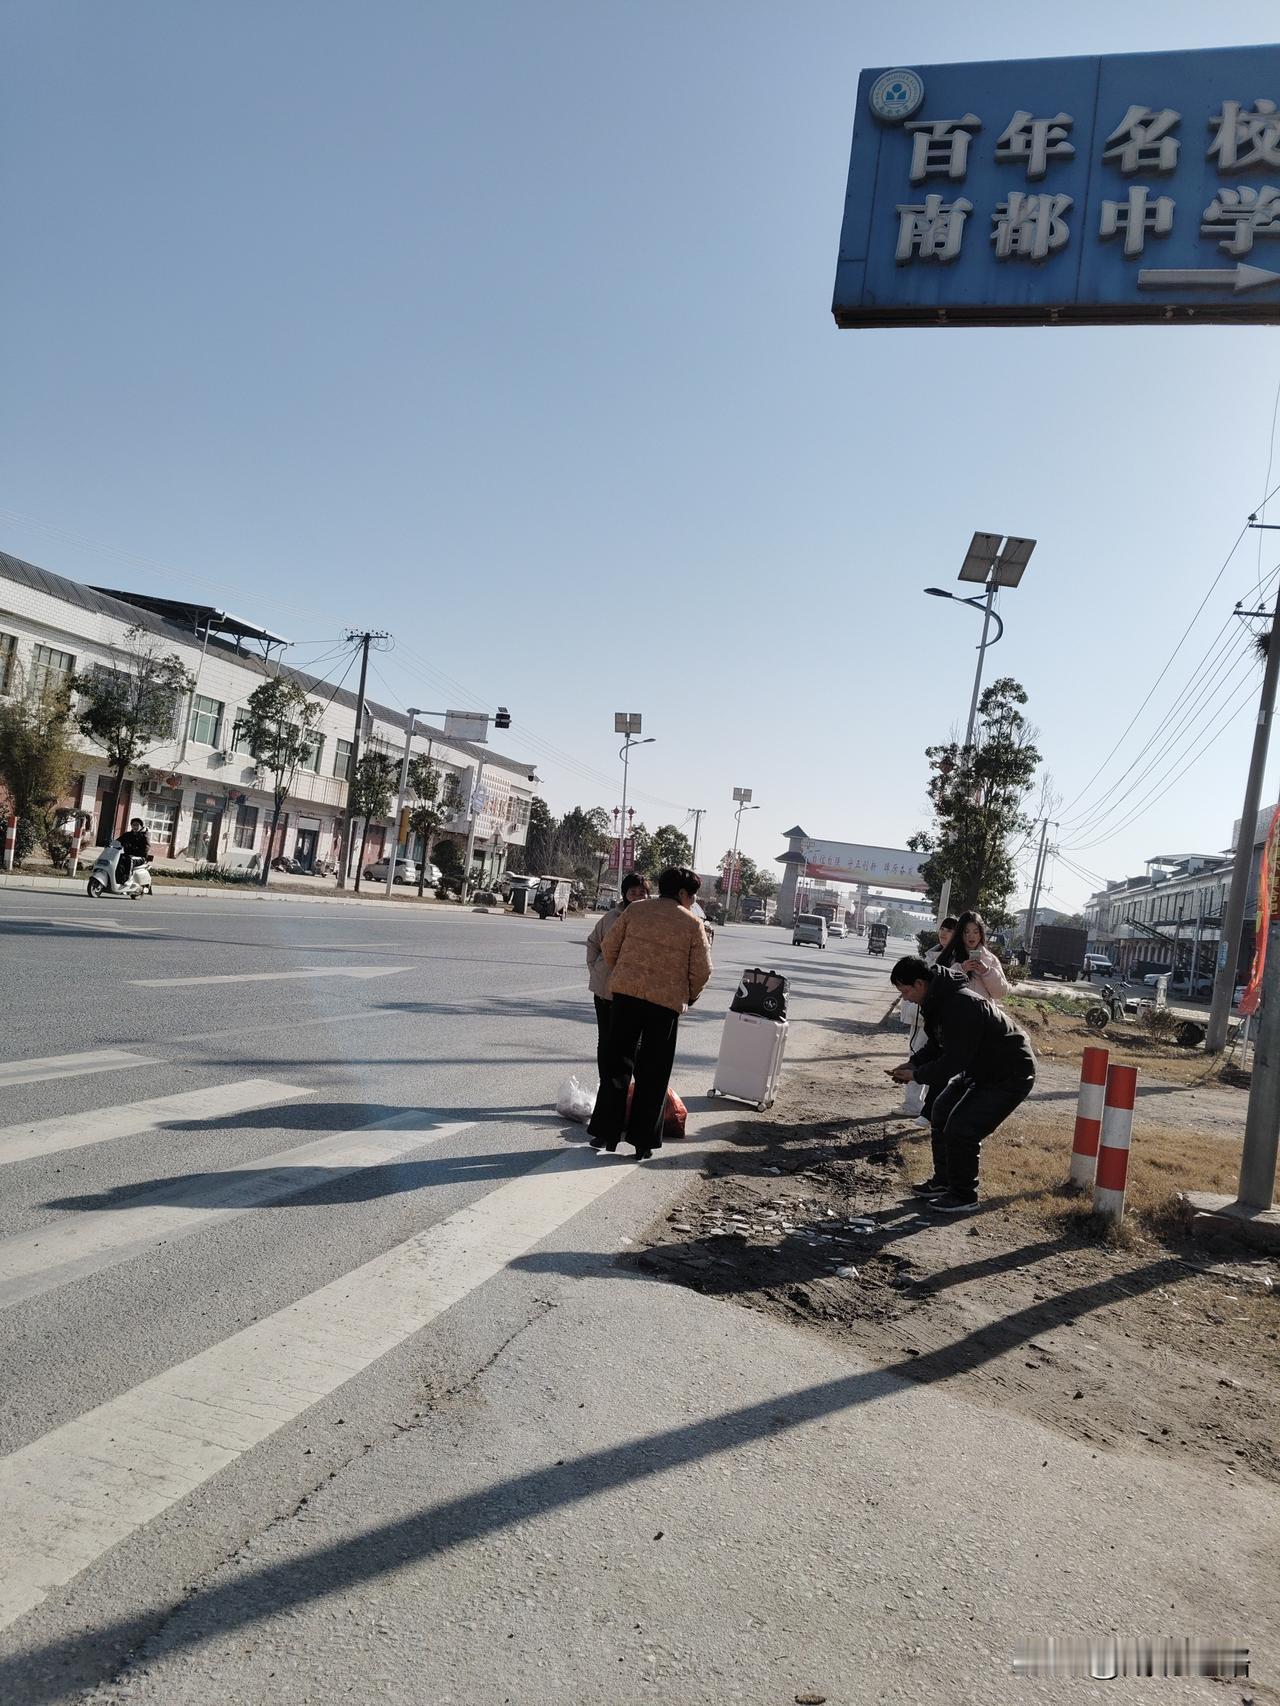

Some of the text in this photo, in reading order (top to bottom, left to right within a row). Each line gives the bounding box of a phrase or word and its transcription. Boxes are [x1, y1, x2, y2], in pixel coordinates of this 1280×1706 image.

[904, 99, 1280, 181] 百年名校
[895, 186, 1280, 261] 南都中学
